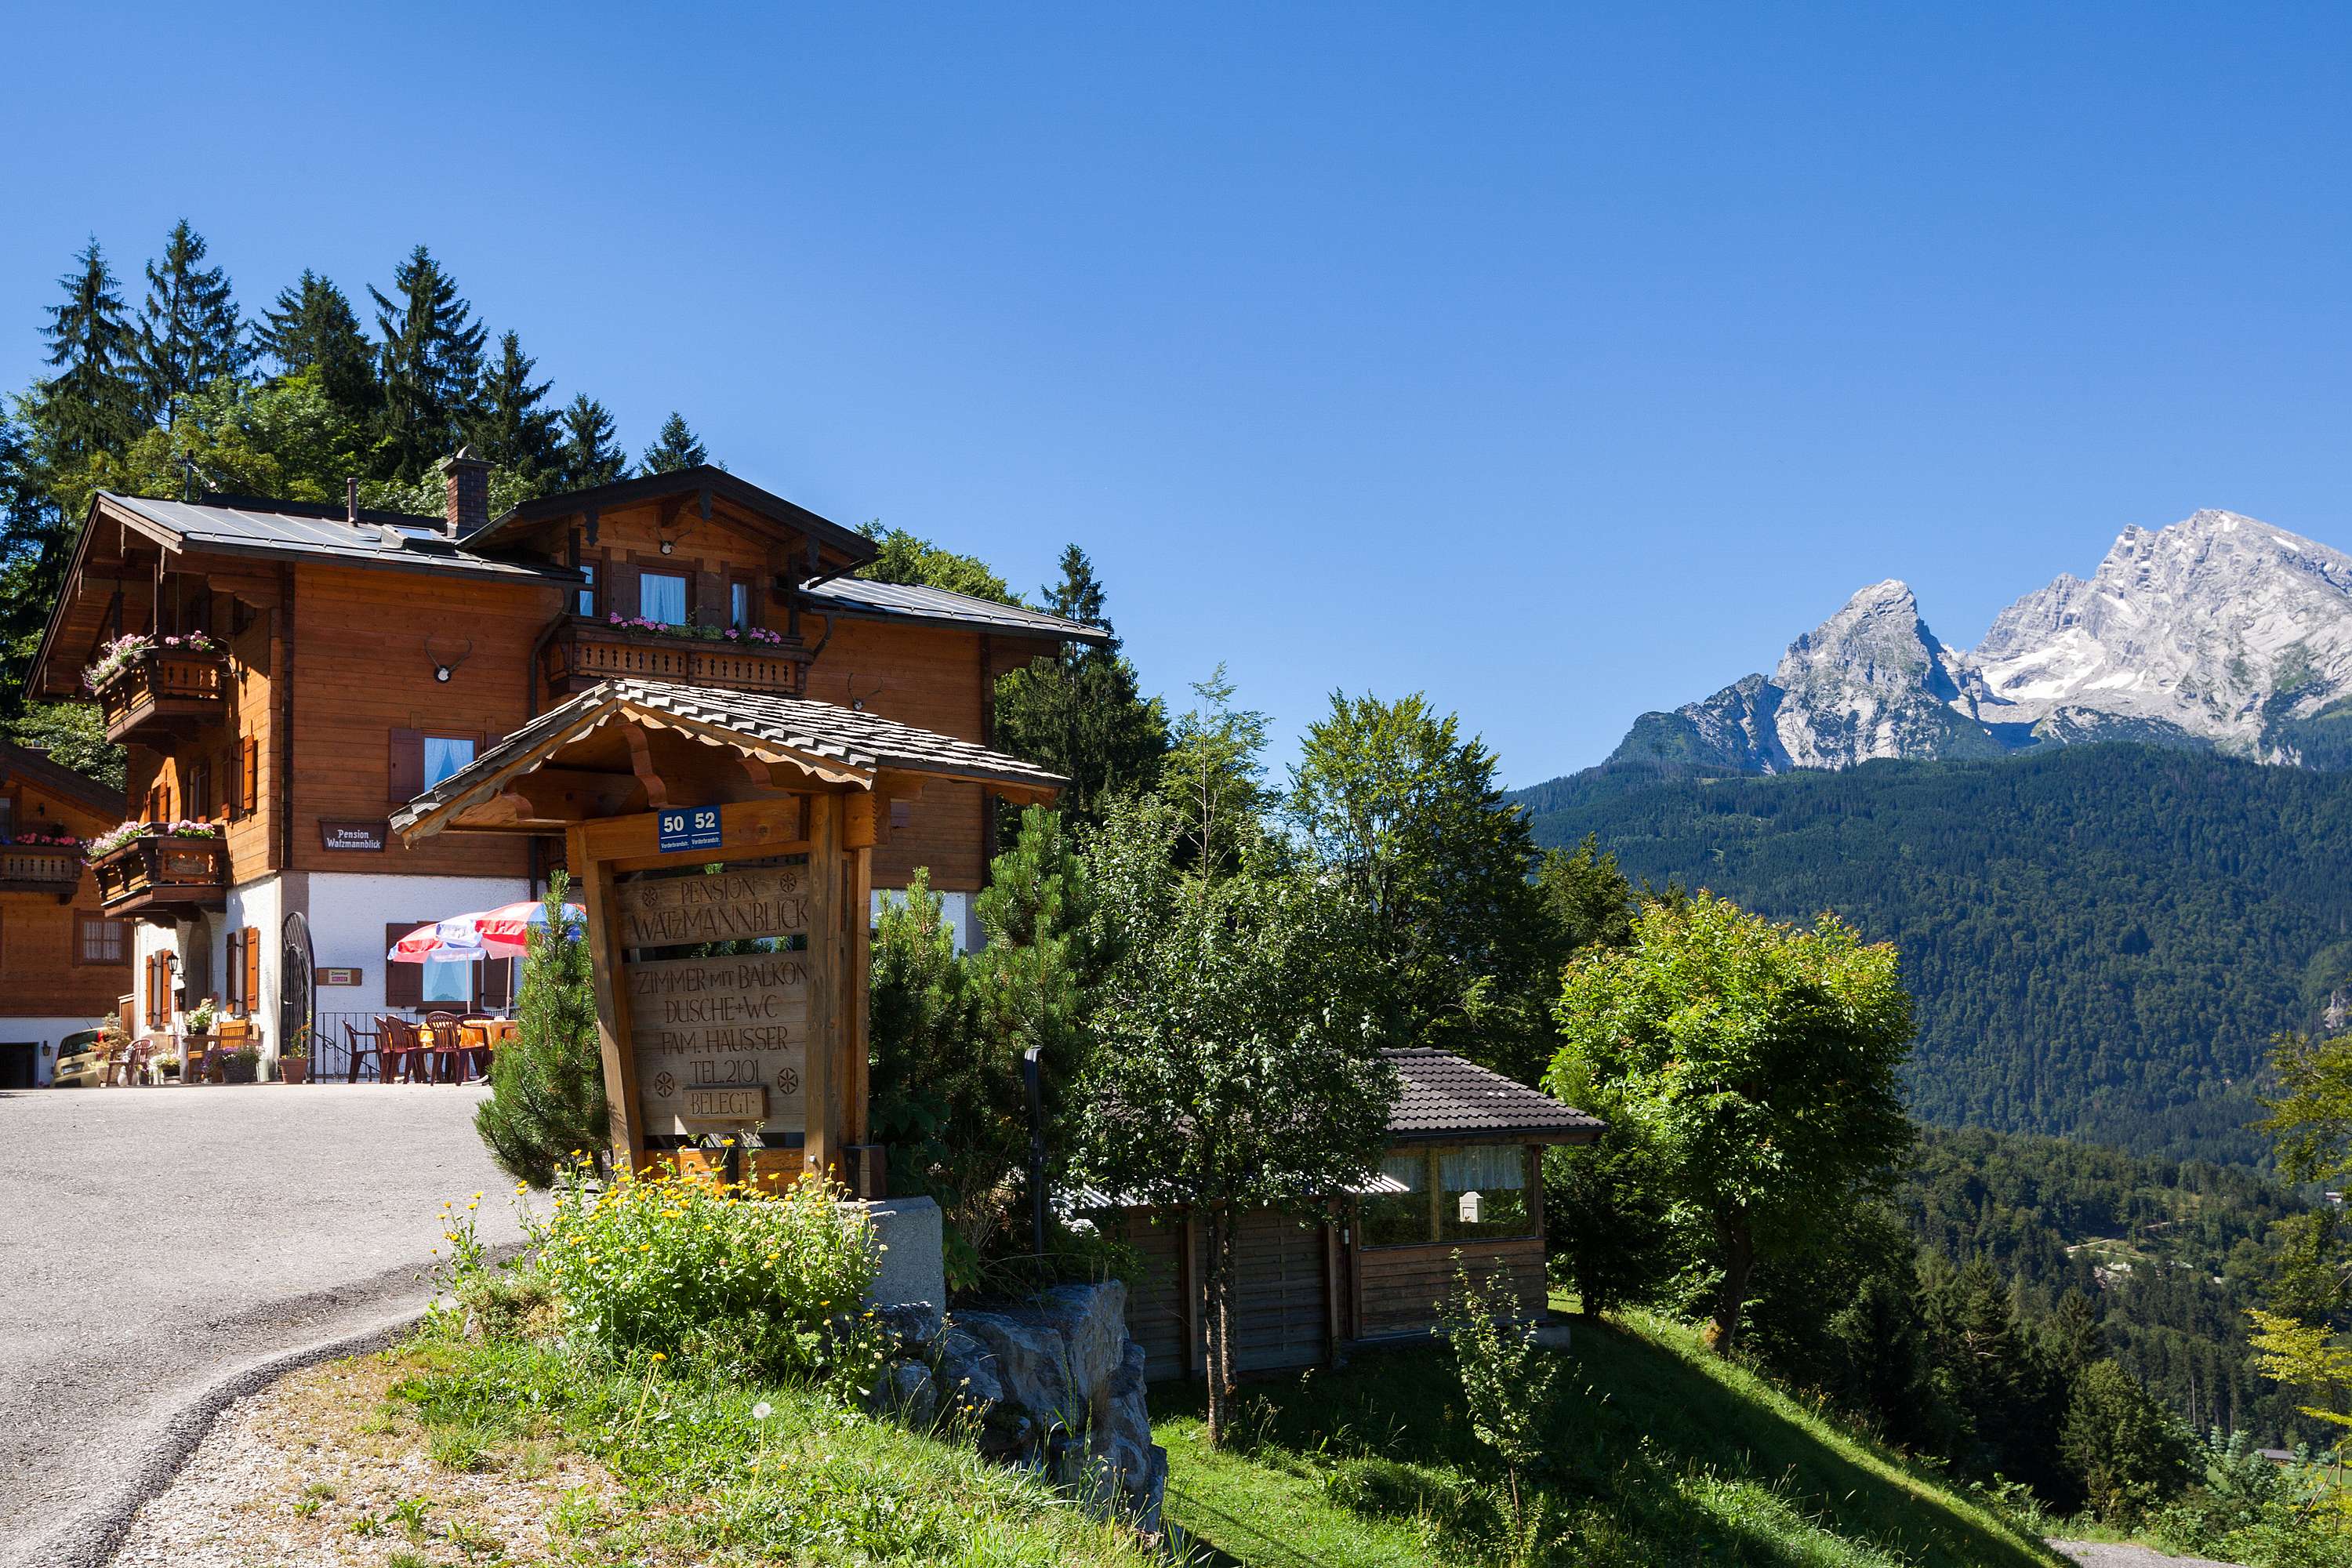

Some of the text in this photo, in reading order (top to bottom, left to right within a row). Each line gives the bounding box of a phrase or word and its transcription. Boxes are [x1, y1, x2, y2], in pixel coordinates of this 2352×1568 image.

[664, 815, 684, 833] 50
[695, 811, 716, 829] 52
[326, 837, 381, 848] Watzmannblick
[337, 829, 369, 839] Pension
[681, 876, 758, 904] PENSION
[635, 961, 808, 994] ZIMMER MIT BALKON
[661, 1030, 702, 1055] FAM.
[691, 1092, 753, 1116] BELEGT
